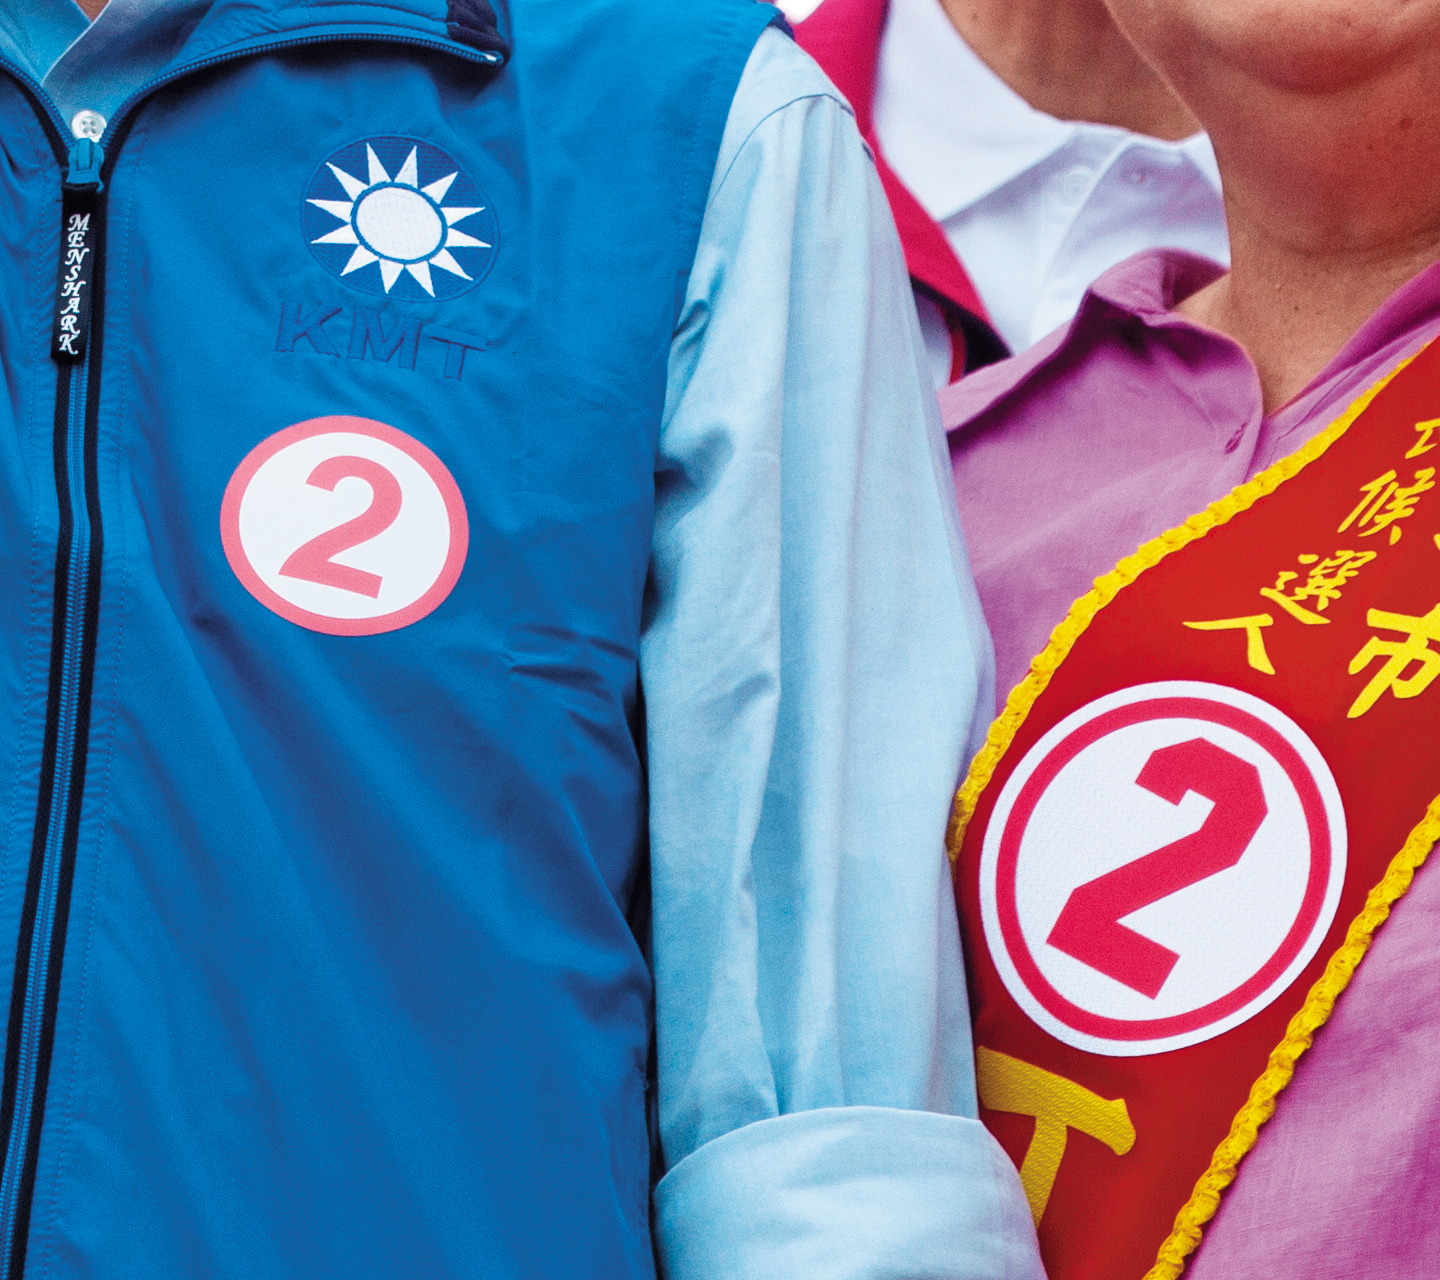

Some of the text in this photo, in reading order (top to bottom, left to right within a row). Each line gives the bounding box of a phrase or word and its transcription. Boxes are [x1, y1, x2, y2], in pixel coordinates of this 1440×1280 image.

[58, 212, 92, 356] MENSHARK
[274, 301, 488, 381] KMT
[277, 454, 404, 600] 2
[1045, 736, 1270, 1001] 2
